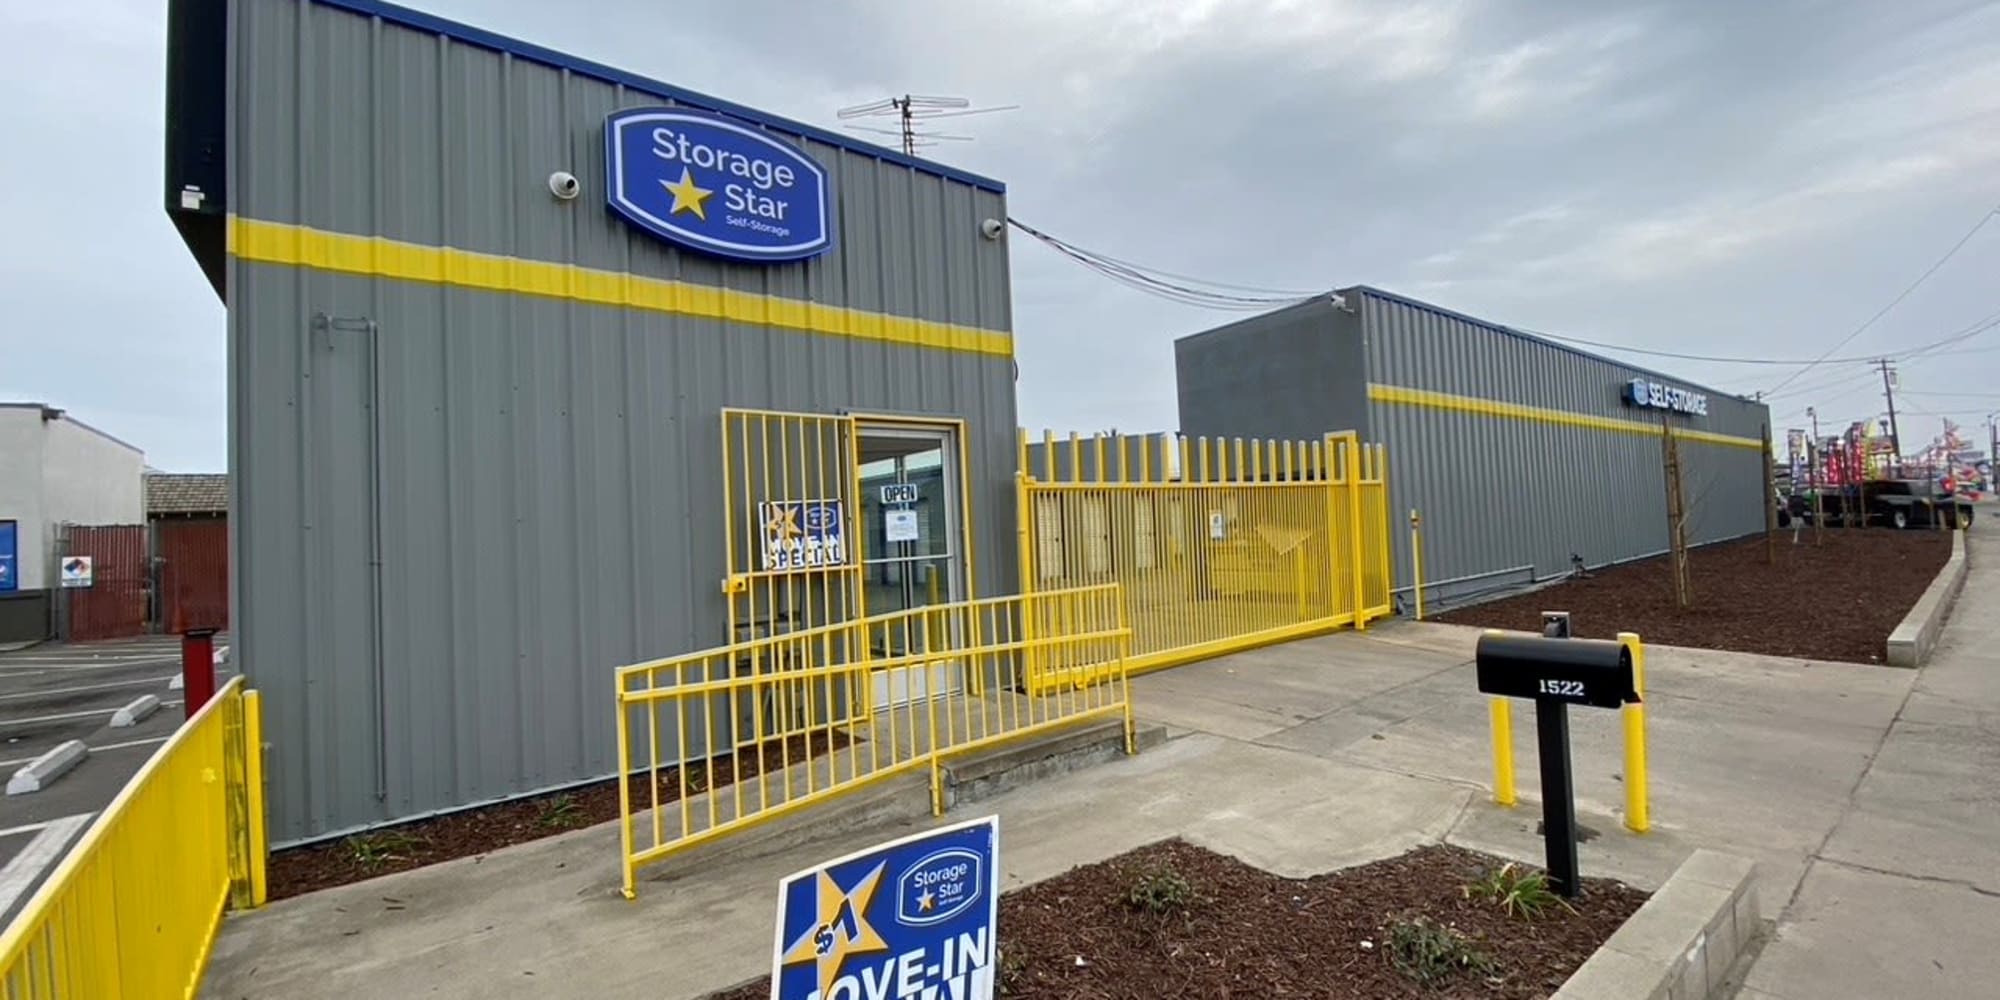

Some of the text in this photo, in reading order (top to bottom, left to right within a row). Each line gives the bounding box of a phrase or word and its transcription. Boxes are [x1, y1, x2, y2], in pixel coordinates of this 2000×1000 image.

[652, 127, 795, 190] Storage
[725, 183, 788, 220] Star
[725, 215, 791, 237] Self-Storage
[884, 485, 915, 502] OPEN
[1539, 679, 1585, 696] 1522
[914, 862, 968, 888] Storage
[938, 881, 964, 898] Star
